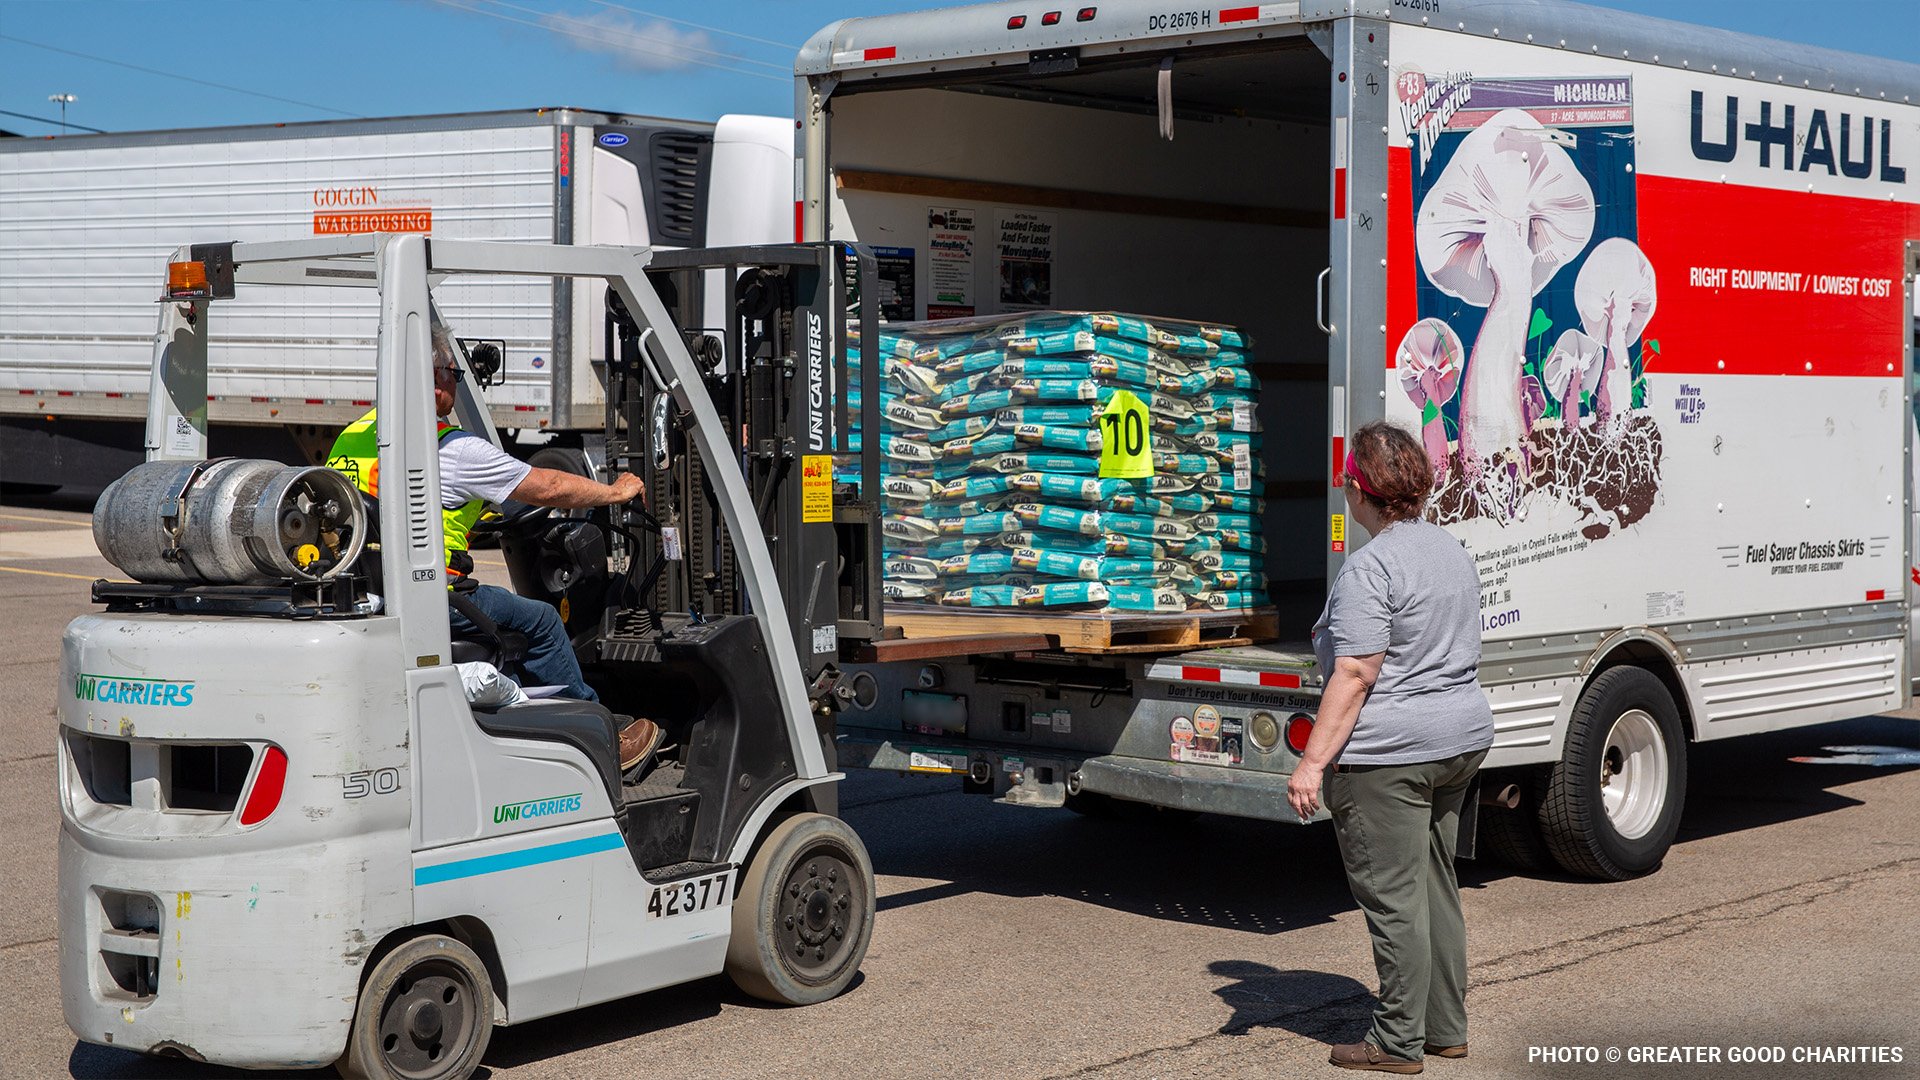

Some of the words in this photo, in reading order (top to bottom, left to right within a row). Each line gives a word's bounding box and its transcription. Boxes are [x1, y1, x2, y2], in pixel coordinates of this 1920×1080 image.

[1149, 15, 1168, 31] DC
[1170, 11, 1198, 28] 2676
[1201, 9, 1211, 26] H
[1399, 72, 1420, 96] #83
[1554, 82, 1626, 103] MICHIGAN
[1400, 80, 1447, 136] Venture
[1419, 83, 1471, 177] America
[1690, 89, 1907, 185] U-HAUL
[314, 187, 378, 207] GOGGIN
[318, 214, 428, 232] WAREHOUSING
[1001, 219, 1028, 231] Loaded
[1029, 221, 1052, 233] Faster
[1001, 231, 1016, 242] And
[1017, 232, 1030, 243] For
[1031, 234, 1050, 245] Less!
[1001, 244, 1051, 261] MovingHelp
[1690, 266, 1728, 288] RIGHT
[1731, 269, 1802, 292] EQUIPMENT
[1802, 274, 1810, 293] /
[1812, 275, 1858, 296] LOWEST
[1861, 278, 1892, 298] COST
[1680, 384, 1701, 396] Where
[891, 406, 916, 422] ACANA
[1675, 398, 1688, 410] Will
[1689, 397, 1696, 413] U
[1697, 398, 1706, 410] Go
[1680, 411, 1701, 424] Next?
[1106, 407, 1144, 457] 10
[894, 445, 920, 457] ACANA
[888, 482, 914, 495] ACANA
[885, 522, 910, 535] ACANA
[1472, 549, 1501, 565] (Armillaria
[1502, 542, 1521, 559] gallica)
[1522, 541, 1528, 551] in
[1528, 536, 1547, 551] Crystal
[1547, 533, 1561, 545] Falls
[1561, 529, 1579, 542] weighs
[1746, 543, 1768, 564] Fuel
[1799, 540, 1836, 560] Chassis
[1837, 538, 1866, 557] Skirts
[1479, 564, 1495, 576] acres.
[1496, 559, 1511, 573] Could
[1518, 554, 1530, 566] have
[1531, 547, 1556, 563] originated
[1556, 545, 1568, 556] from
[1574, 538, 1588, 553] single
[415, 570, 434, 580] LPG
[891, 563, 917, 575] ACANA
[1771, 563, 1794, 576] OPTIMIZE
[1794, 562, 1808, 574] YOUR
[1808, 562, 1821, 573] FUEL
[1821, 560, 1845, 572] ECONOMY
[1496, 572, 1509, 587] ago?
[884, 587, 903, 598] CANA
[1479, 593, 1488, 610] GI
[1481, 608, 1521, 632] l.com
[1167, 684, 1193, 697] Don't
[1194, 686, 1226, 701] Forget
[1227, 689, 1248, 702] Your
[1250, 692, 1285, 706] Moving
[1286, 695, 1319, 709] Suppli
[342, 767, 401, 799] 50
[647, 874, 729, 918] 42377
